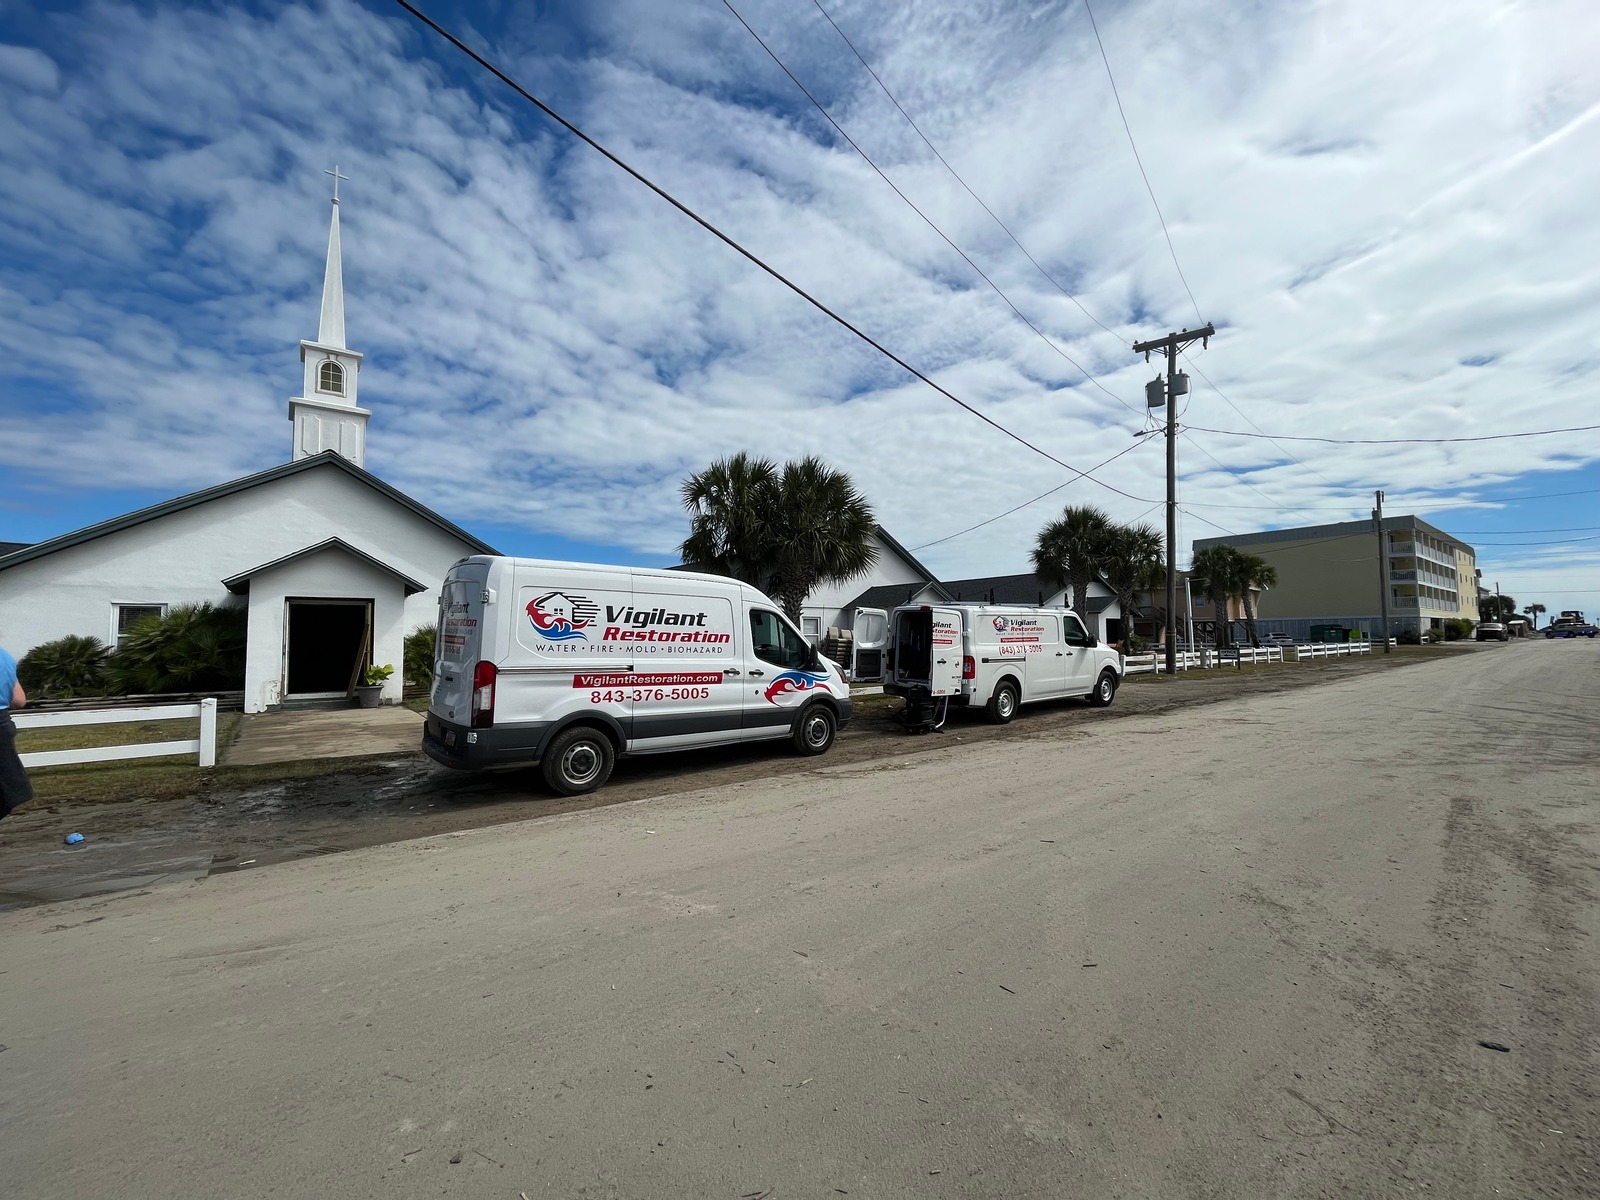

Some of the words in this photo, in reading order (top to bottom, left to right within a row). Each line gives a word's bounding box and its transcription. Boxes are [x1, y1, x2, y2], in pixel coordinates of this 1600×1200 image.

[605, 605, 708, 628] Vigilant
[1010, 619, 1038, 627] Vigilant
[603, 627, 730, 643] Restoration
[535, 644, 577, 653] WATER
[590, 644, 615, 653] FIRE
[625, 645, 657, 653] MOLD
[667, 645, 723, 654] BIOHAZARD
[998, 645, 1015, 656] (843)
[581, 675, 718, 687] VigilantRestoration.com
[590, 687, 709, 704] 843-376-5005
